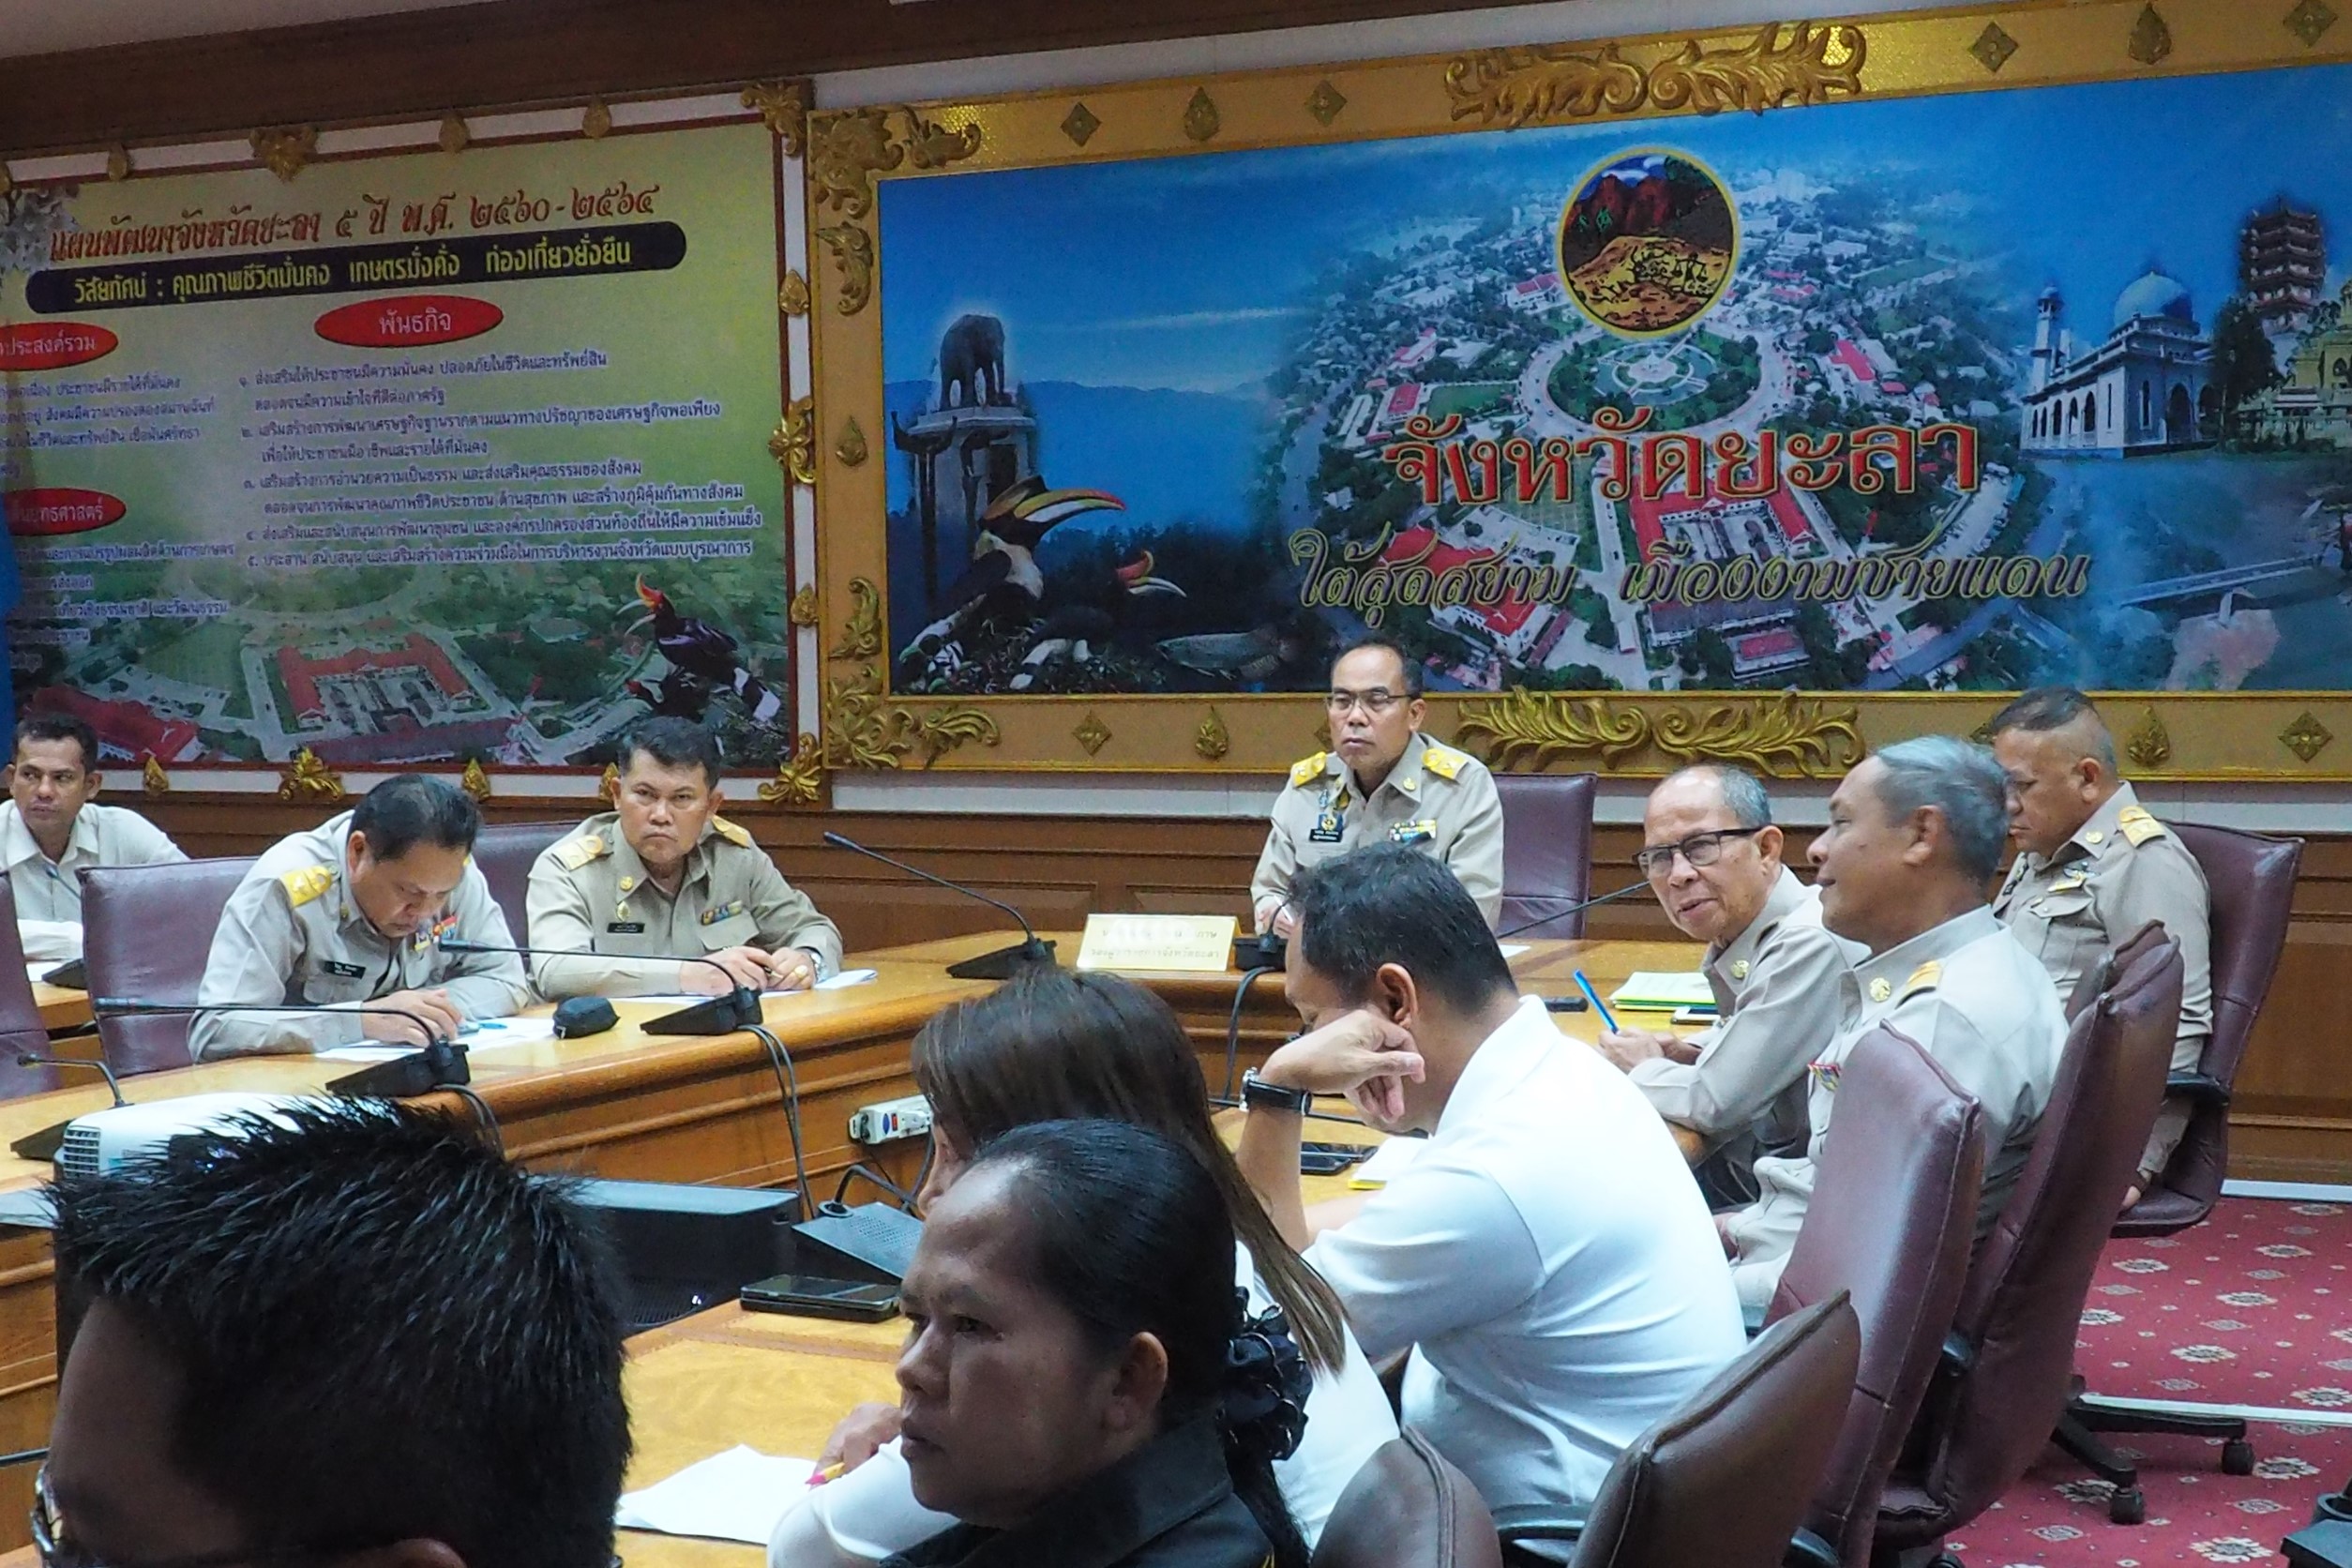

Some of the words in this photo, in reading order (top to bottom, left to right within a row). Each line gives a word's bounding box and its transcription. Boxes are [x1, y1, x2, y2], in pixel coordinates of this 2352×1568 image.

[50, 204, 321, 263] แผนพัฒนาจังหวัดยะลา
[336, 208, 358, 239] ๕
[362, 193, 390, 234] ปี
[74, 270, 147, 304] วิสัยทัศน์
[173, 254, 331, 303] คุณภาพชีวิตมั่นคง
[350, 243, 460, 282] เกษตรมั่งคั่ง
[486, 232, 632, 274] ท่องเที่ยวยั่งยืน
[378, 307, 452, 336] พันธกิจ
[1383, 406, 1980, 505] จังหวัดยะลา
[1289, 520, 1579, 627] ใต้สุดสยาม
[1619, 520, 2089, 608] เมืองงามชายแดน
